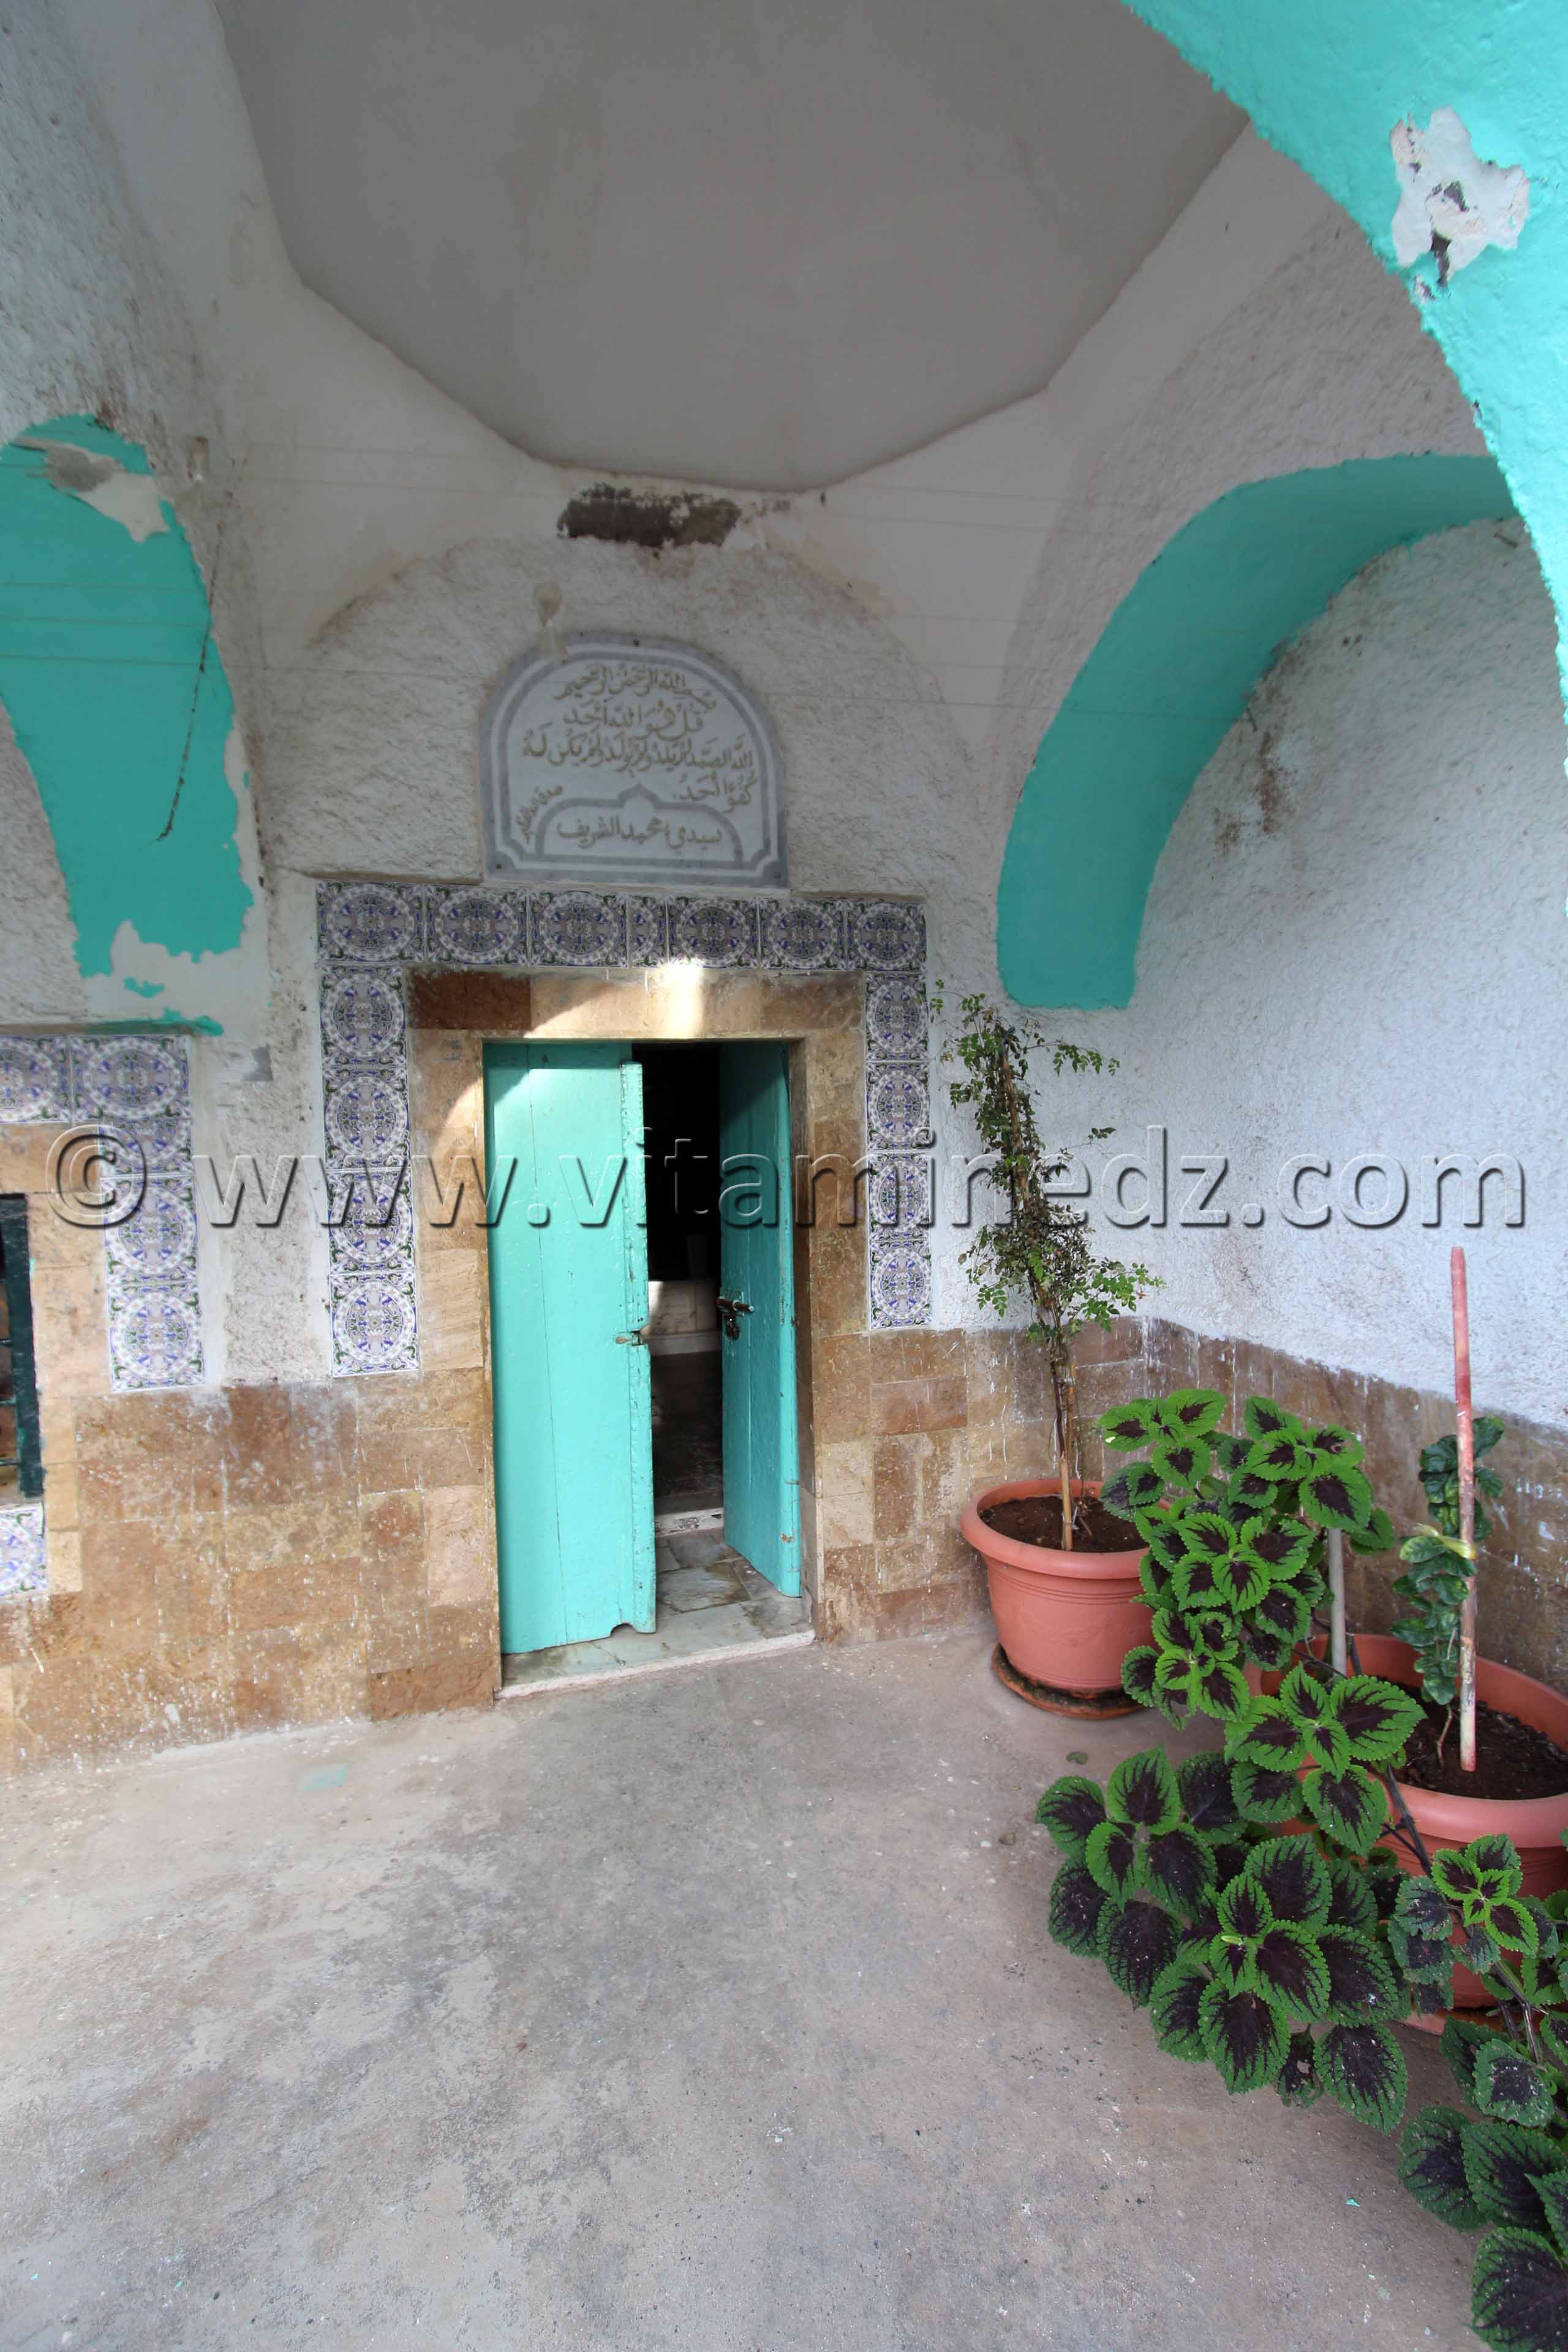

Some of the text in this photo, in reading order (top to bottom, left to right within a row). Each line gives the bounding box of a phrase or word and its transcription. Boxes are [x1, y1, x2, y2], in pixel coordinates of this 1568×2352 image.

[657, 668, 685, 690] الله
[608, 706, 641, 728] الله
[728, 733, 750, 771] الله
